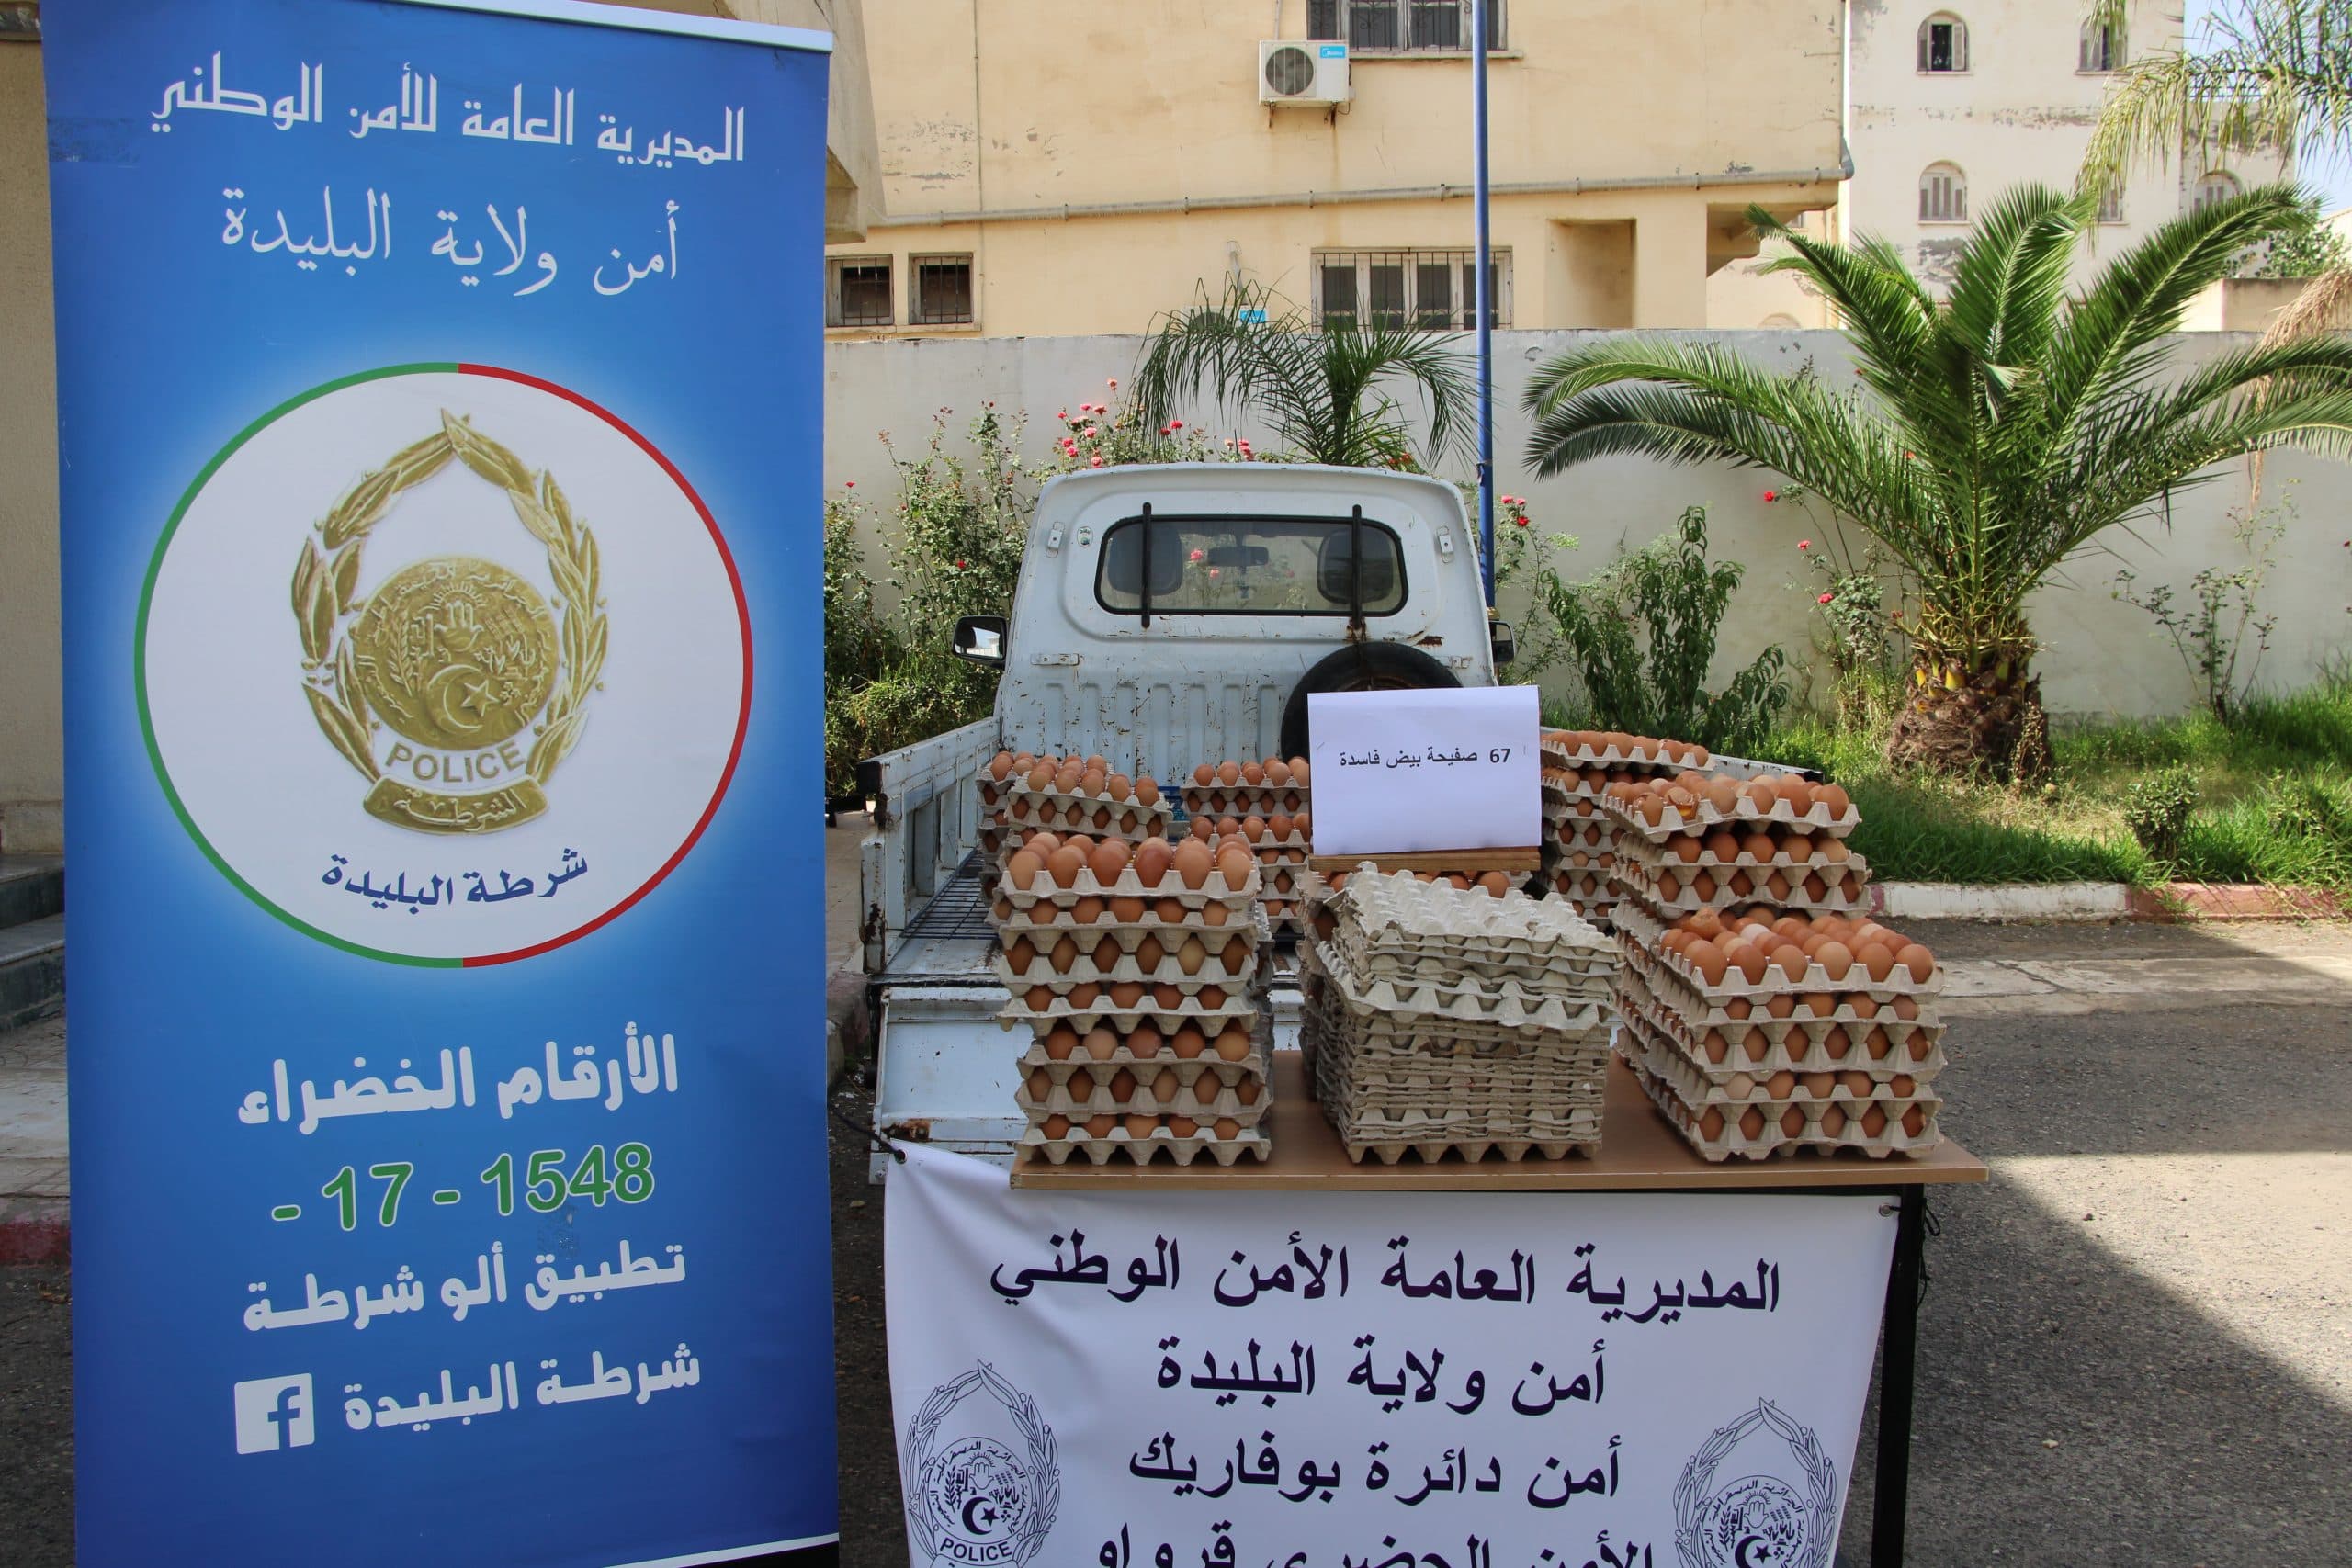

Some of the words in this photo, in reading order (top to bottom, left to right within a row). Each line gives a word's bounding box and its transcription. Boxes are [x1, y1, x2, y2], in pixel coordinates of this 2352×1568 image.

[152, 51, 322, 133] الوطني
[349, 62, 437, 139] للأمن
[462, 83, 574, 145] العامة
[597, 106, 744, 168] المديرية
[222, 186, 390, 276] البليدة
[431, 204, 558, 297] ولاية
[594, 199, 680, 297] أمن
[384, 740, 527, 784] POLICE
[1339, 749, 1381, 767] فاسدة
[1385, 748, 1422, 769] بيض
[1426, 746, 1478, 767] صفيحة
[1488, 748, 1512, 764] 67
[322, 853, 454, 915] البليدة
[462, 847, 589, 903] شرطة
[238, 1046, 476, 1135] الخضراء
[497, 1021, 678, 1120] الأرقام
[321, 1161, 414, 1232] 17
[480, 1142, 655, 1216] 1548
[243, 1265, 424, 1331] شرطة
[440, 1241, 507, 1322] ألو
[525, 1239, 685, 1311] تطبيق
[989, 1227, 1180, 1307] الوطني
[1380, 1235, 1535, 1304] العامة
[1566, 1242, 1780, 1325] المديرية
[344, 1361, 519, 1432] البليدة
[537, 1342, 700, 1404] شرطة
[1157, 1335, 1316, 1409] البليدة
[1346, 1334, 1486, 1416] ولاية
[1511, 1338, 1606, 1416] أمن
[1129, 1429, 1340, 1504] بوفاريك
[1365, 1440, 1501, 1506] دائرة
[1527, 1434, 1622, 1509] أمن
[939, 1537, 1012, 1562] POLICE
